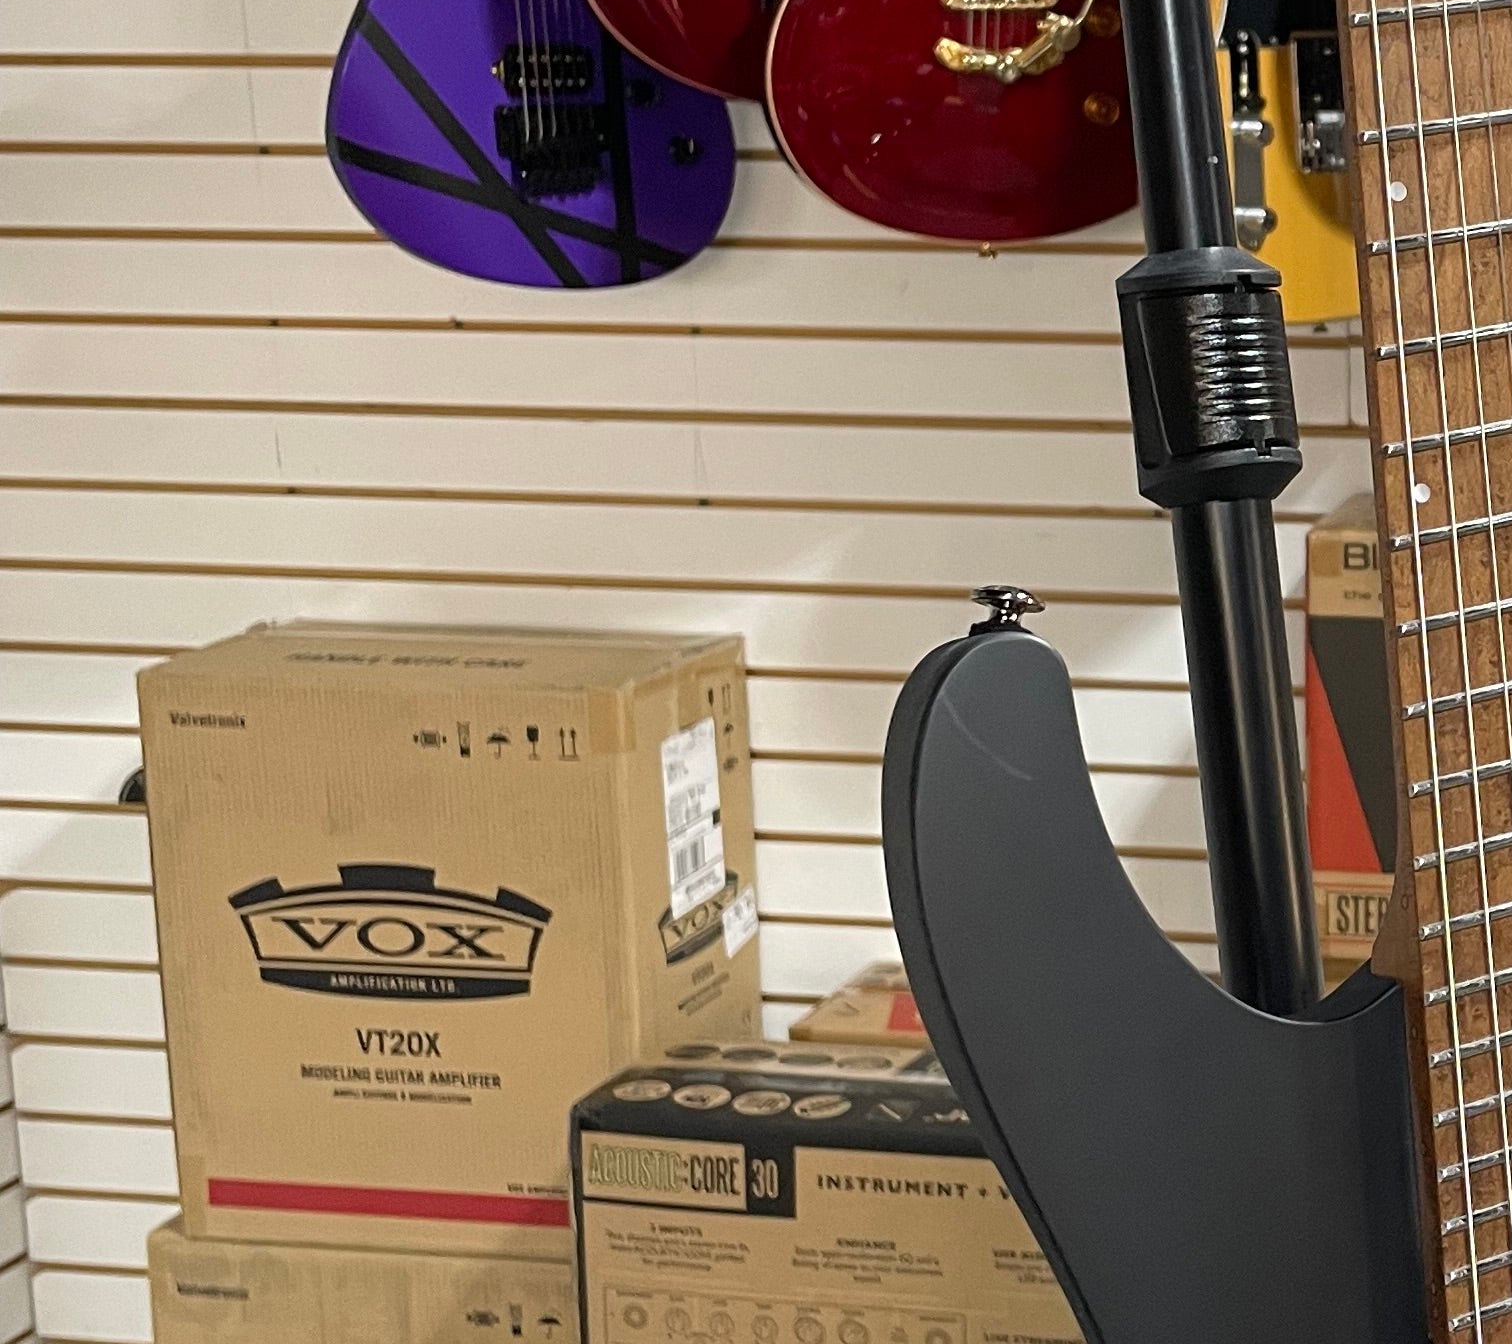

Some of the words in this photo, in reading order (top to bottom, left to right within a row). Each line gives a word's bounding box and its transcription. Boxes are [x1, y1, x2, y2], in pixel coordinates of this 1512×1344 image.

[271, 916, 505, 961] VOX
[329, 973, 428, 993] AMPLIFICATION
[355, 1027, 442, 1058] VT20X
[301, 1062, 372, 1084] MODELING
[375, 1068, 425, 1086] GUITAR
[429, 1071, 502, 1090] AMPLIFIER
[750, 1159, 780, 1200] 30
[816, 1173, 969, 1201] INSTRUMENT
